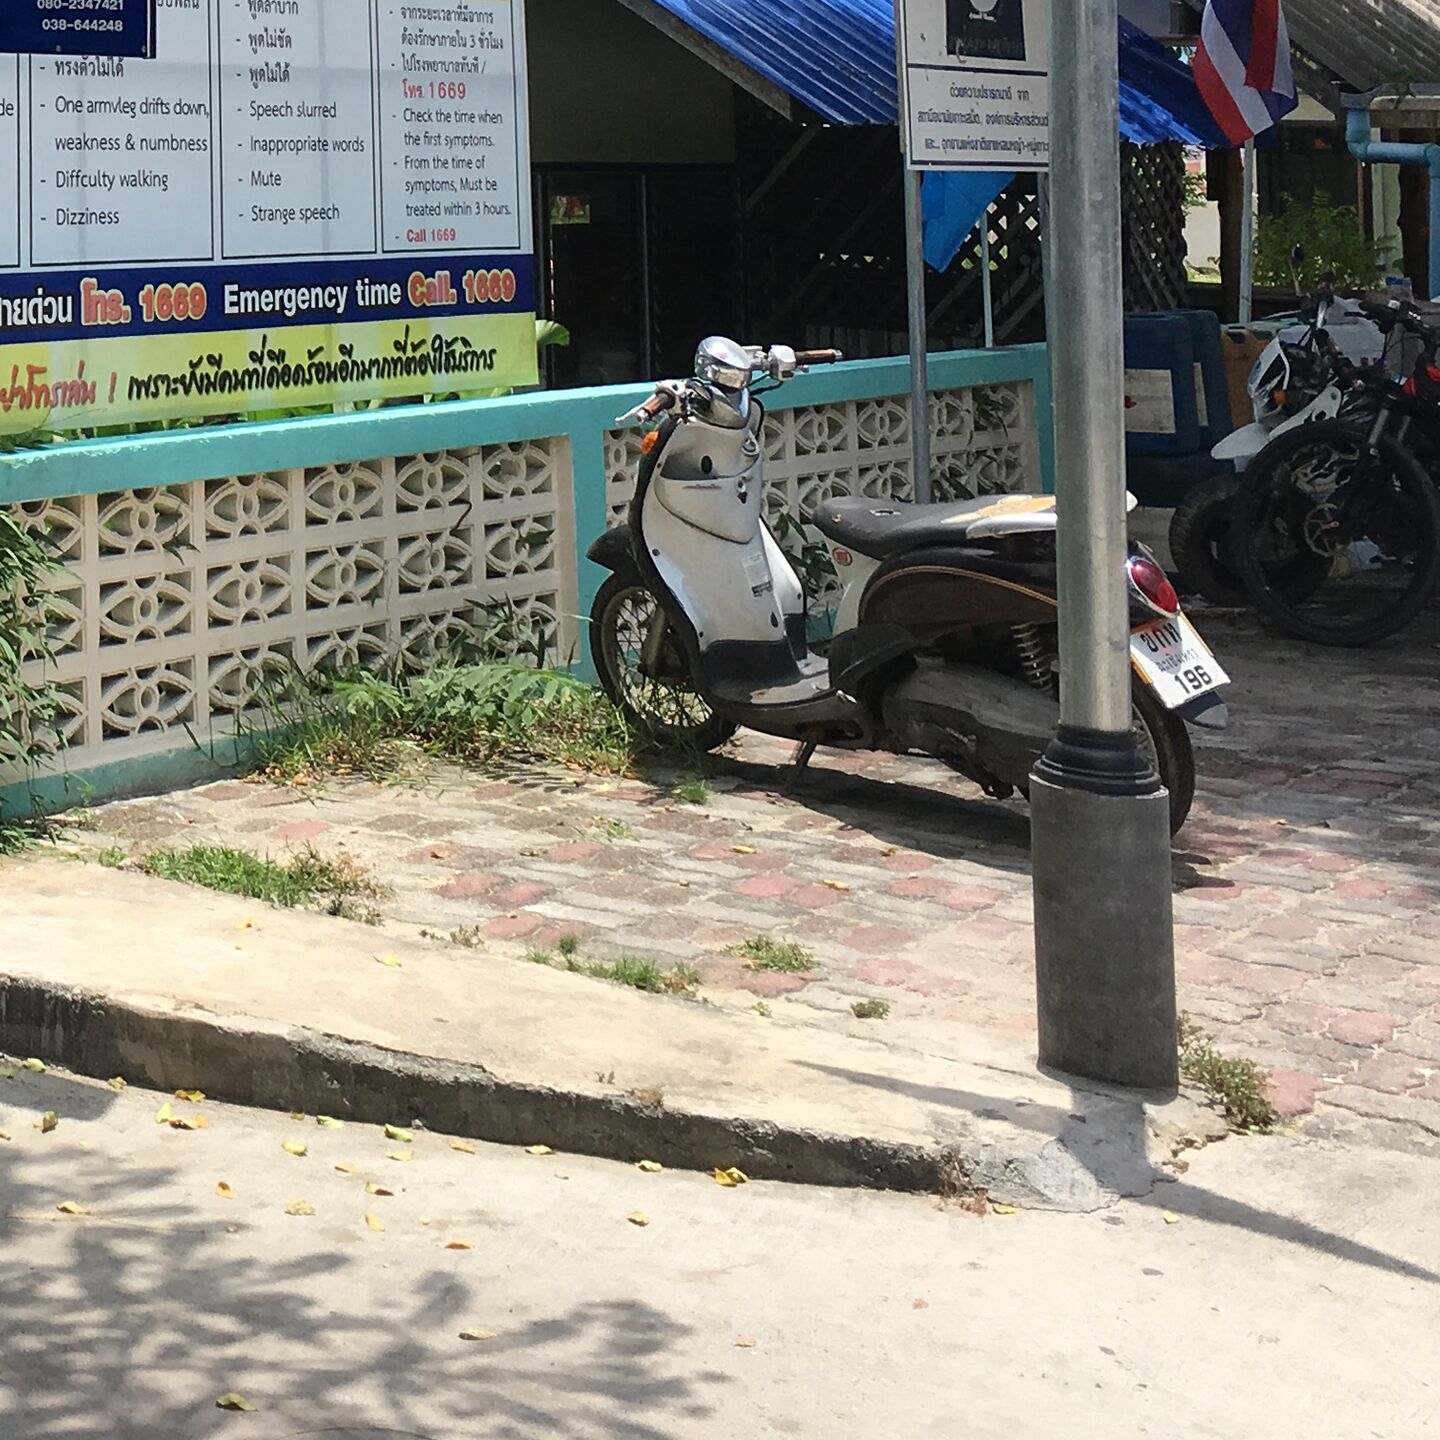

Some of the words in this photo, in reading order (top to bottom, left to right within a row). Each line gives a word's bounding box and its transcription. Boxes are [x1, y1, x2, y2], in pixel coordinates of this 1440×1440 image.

[42, 19, 123, 31] 038-644248
[470, 35, 476, 48] 3
[249, 62, 290, 88] พูดไม่ได้
[429, 81, 466, 99] 1669
[55, 96, 83, 113] One
[140, 97, 170, 114] drifts
[174, 99, 210, 118] down,
[250, 102, 293, 122] Speech
[297, 102, 336, 119] slurred
[403, 108, 432, 122] Check
[436, 109, 452, 123] the
[455, 109, 475, 123] time
[478, 110, 503, 123] when
[55, 133, 120, 150] weakness
[125, 133, 135, 151] &
[140, 134, 208, 151] numbness
[250, 137, 329, 157] Inappropriate
[332, 137, 365, 152] words
[404, 132, 420, 145] the
[424, 132, 442, 146] first
[445, 133, 495, 149] symptoms.
[404, 156, 429, 169] From
[433, 155, 449, 169] the
[452, 155, 472, 169] time
[475, 156, 486, 169] of
[120, 170, 168, 191] walking
[251, 171, 282, 187] Mute
[460, 177, 483, 191] Must
[486, 177, 497, 191] be
[56, 208, 120, 225] Dizziness
[251, 205, 295, 224] Strange
[299, 204, 340, 222] speech
[406, 202, 441, 216] treated
[444, 202, 472, 216] within
[475, 202, 480, 215] 3
[483, 201, 511, 215] hours.
[407, 229, 426, 242] Call
[431, 229, 456, 241] 1669
[81, 279, 131, 326] โทร.
[140, 282, 207, 322] 1669
[224, 283, 348, 317] Emergency
[356, 279, 401, 306] time
[409, 271, 456, 307] Call.
[462, 269, 516, 304] 1669
[1175, 665, 1212, 694] 196
